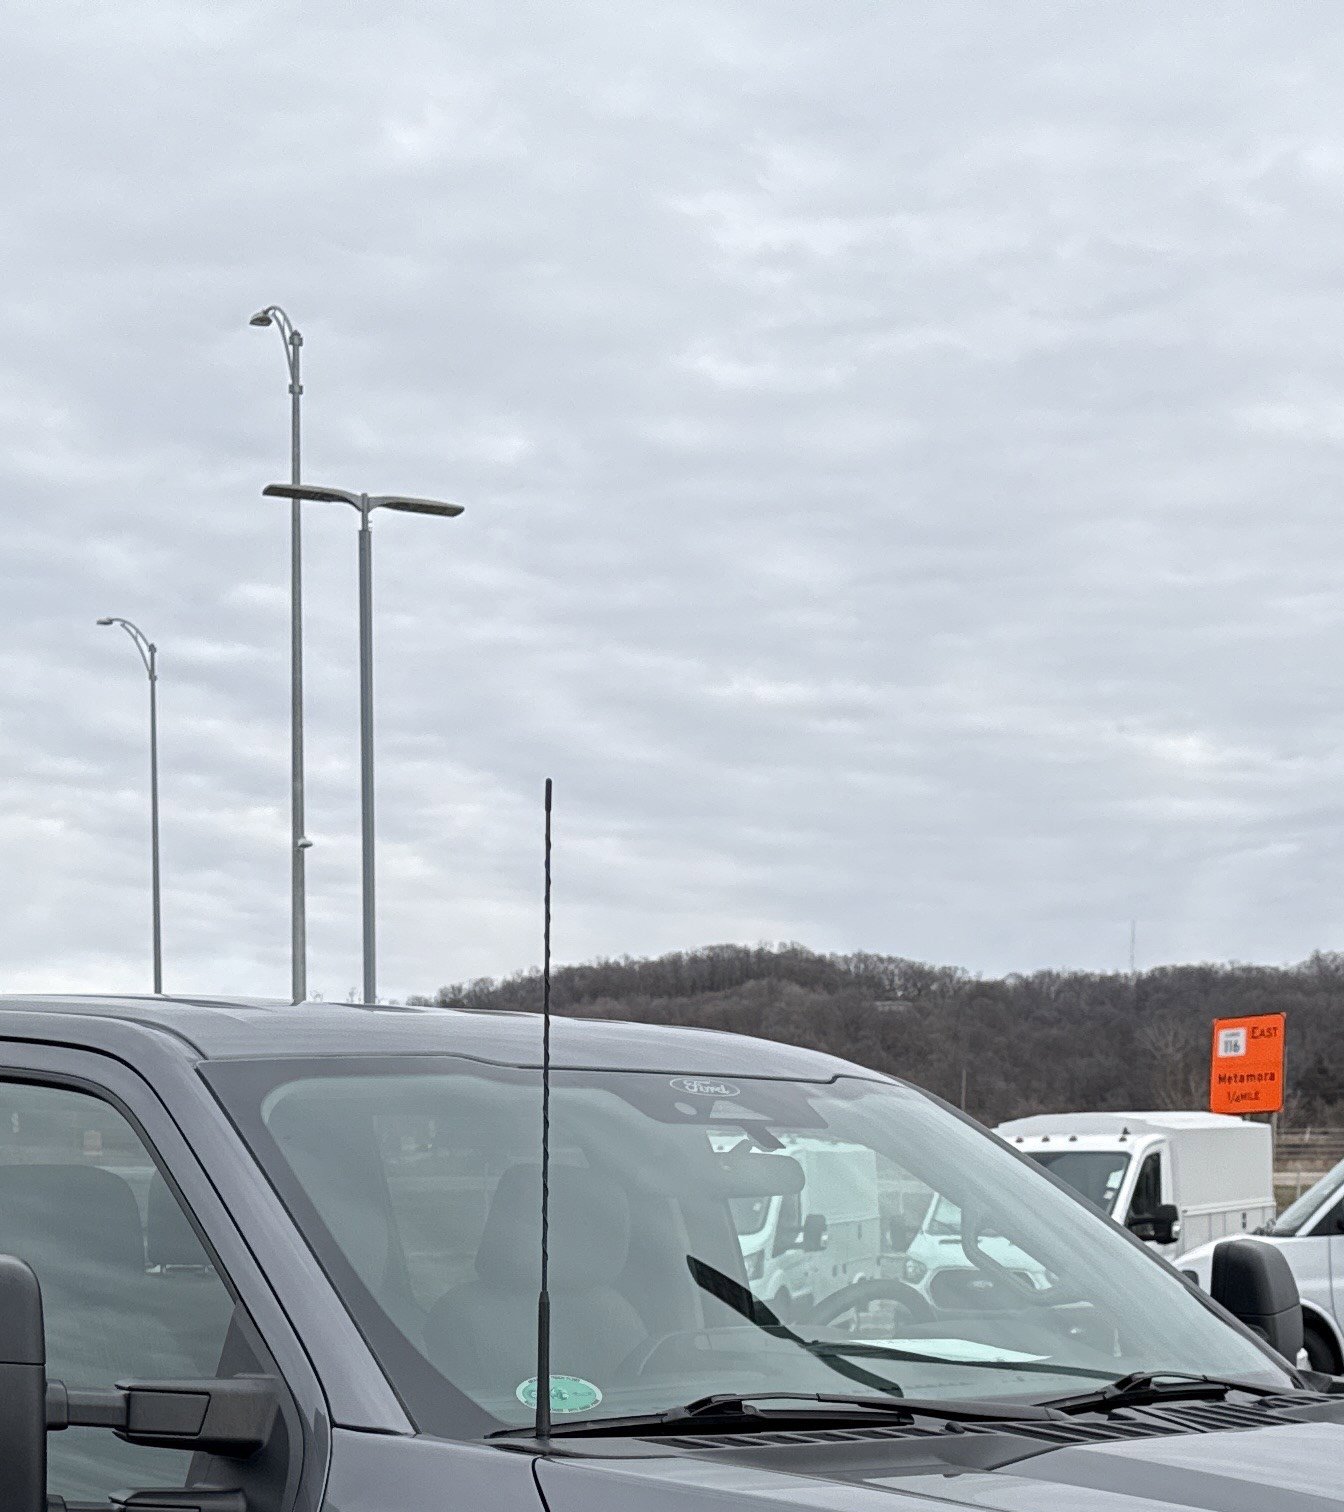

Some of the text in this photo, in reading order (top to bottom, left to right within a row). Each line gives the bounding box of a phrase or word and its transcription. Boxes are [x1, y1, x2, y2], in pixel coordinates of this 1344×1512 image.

[1251, 1026, 1278, 1039] EAST
[1218, 1071, 1276, 1085] Metamora
[682, 1077, 730, 1096] Ford
